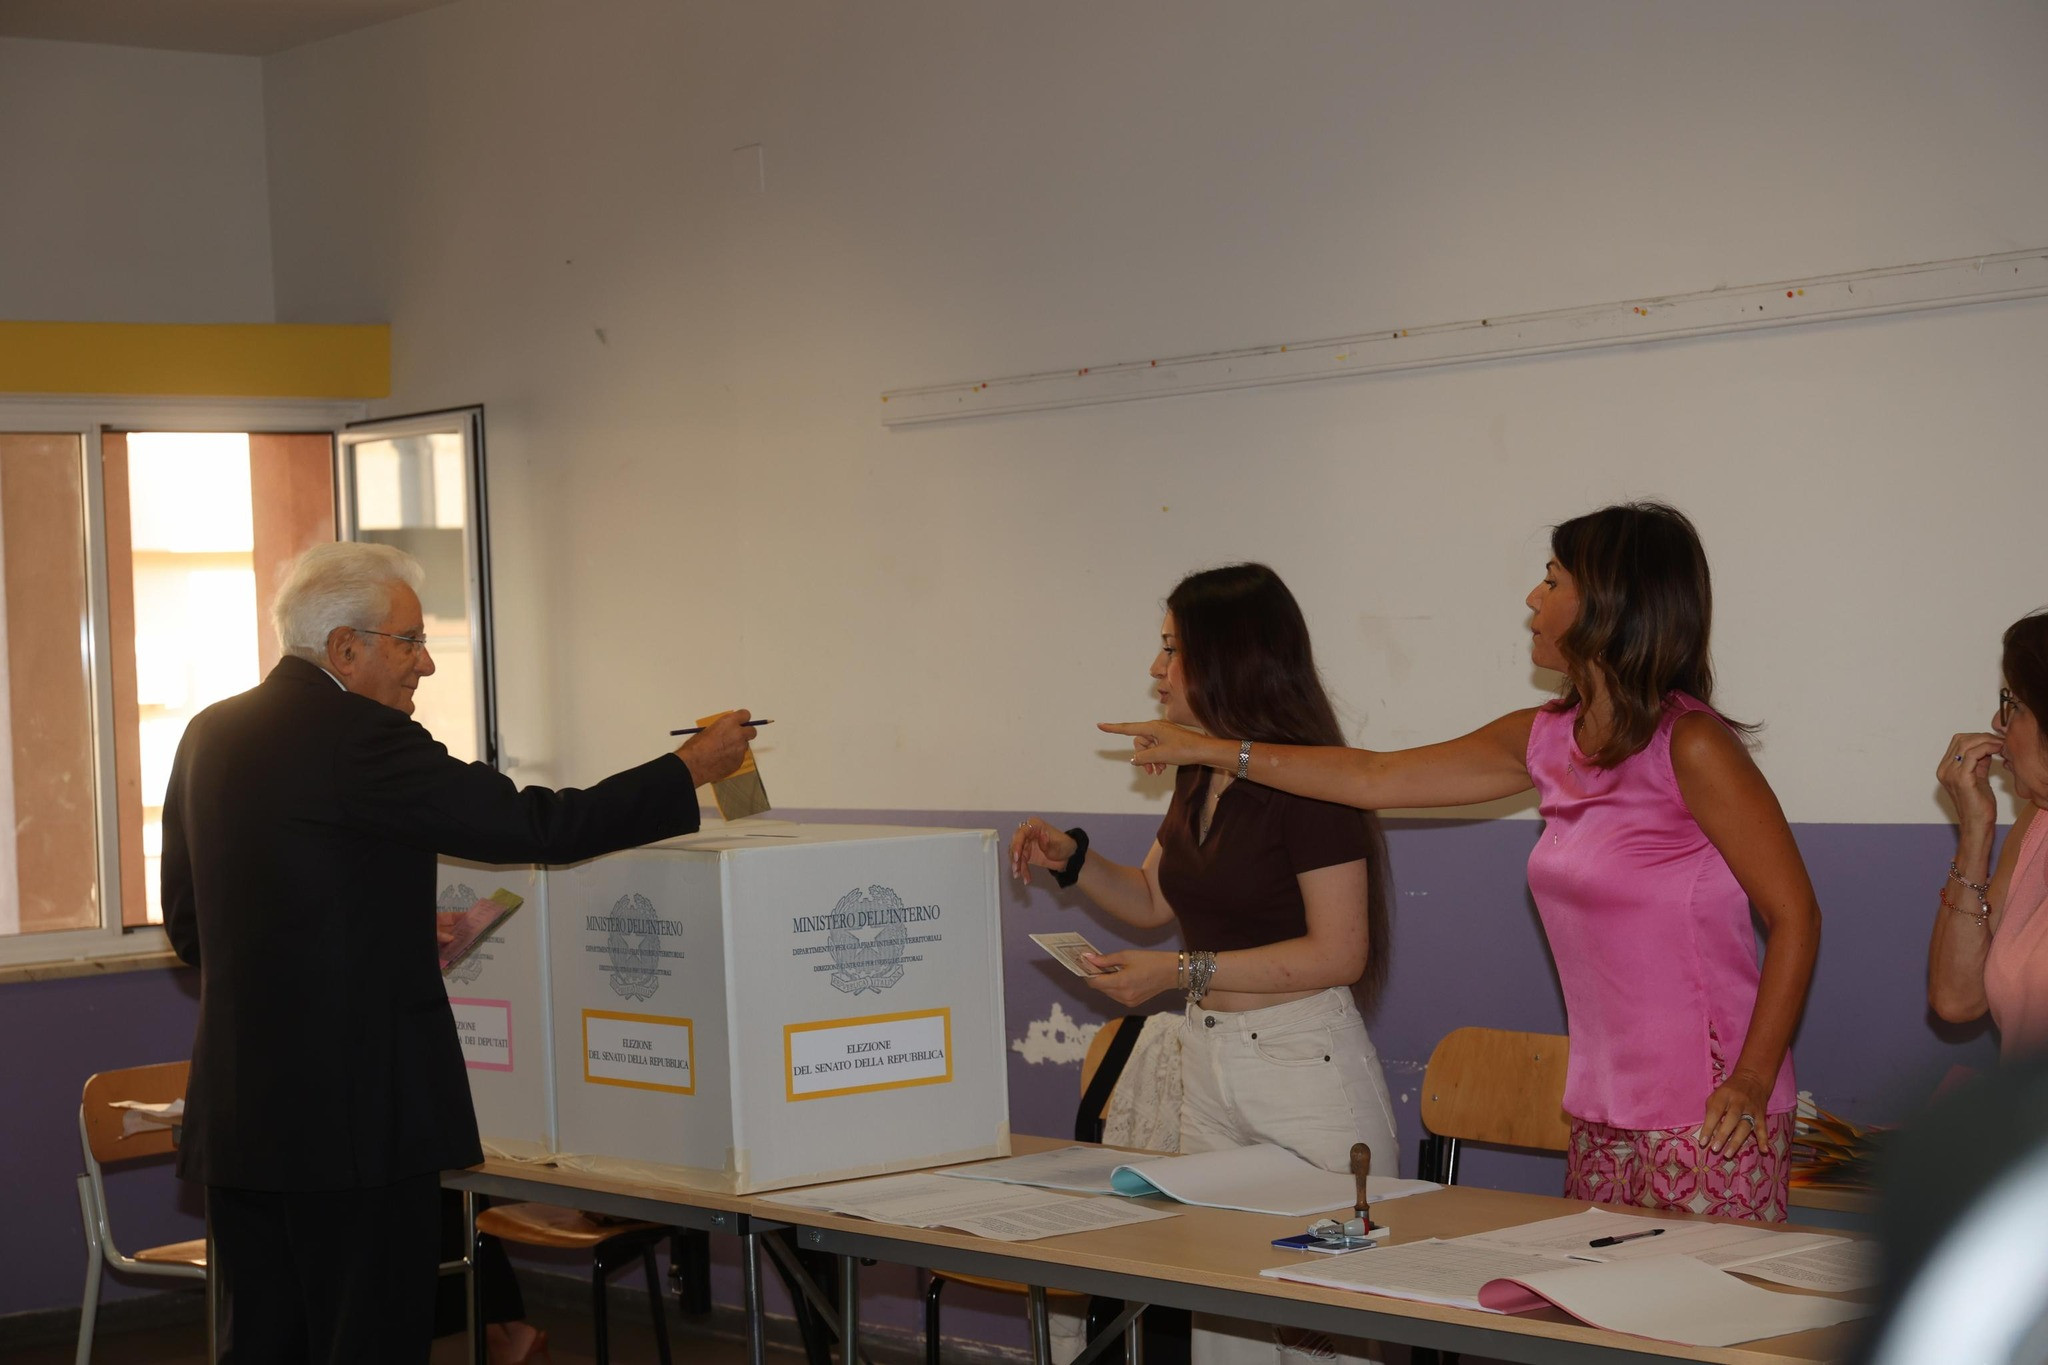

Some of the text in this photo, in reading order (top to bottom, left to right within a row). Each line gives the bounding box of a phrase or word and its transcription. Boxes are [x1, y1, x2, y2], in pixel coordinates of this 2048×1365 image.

[586, 915, 684, 937] MINISTERO DELL'INTERNO
[793, 904, 941, 933] MINISTERO DELL'INTERNO
[792, 945, 834, 956] DIPARTIMENTO
[904, 934, 942, 944] TERRITORIALI
[455, 1021, 476, 1031] ZIONE
[465, 1035, 476, 1045] DEI
[477, 1036, 508, 1048] DEPUTATI
[622, 1038, 653, 1050] ELEZIONE
[847, 1040, 891, 1054] ELEZIONE
[589, 1050, 689, 1070] DEL SENATO DELLA REPUBBLICA
[794, 1049, 944, 1076] DEL SENATO DELLA REPUBBLICA
